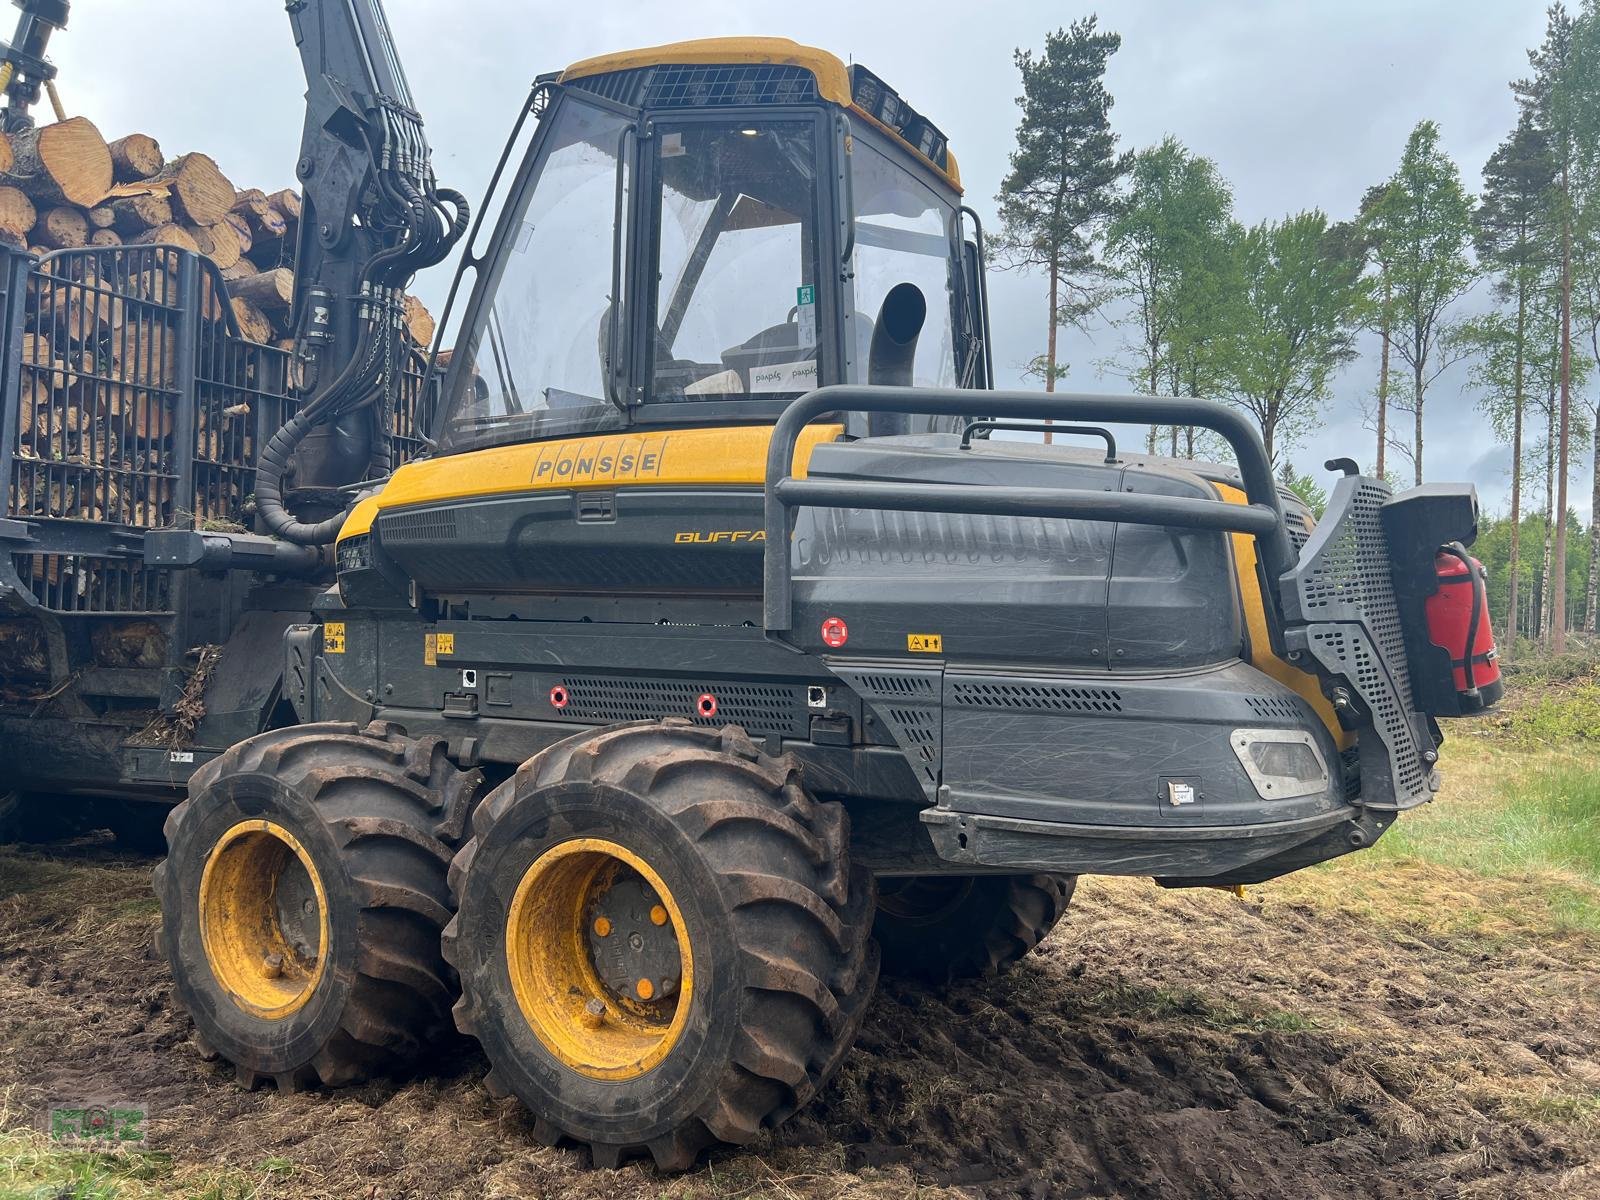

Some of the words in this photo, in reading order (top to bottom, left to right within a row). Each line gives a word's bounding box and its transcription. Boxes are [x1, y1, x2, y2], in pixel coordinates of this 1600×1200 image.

[755, 370, 781, 384] Sydved
[537, 453, 657, 477] PONSSE
[674, 530, 796, 544] BUFFA
